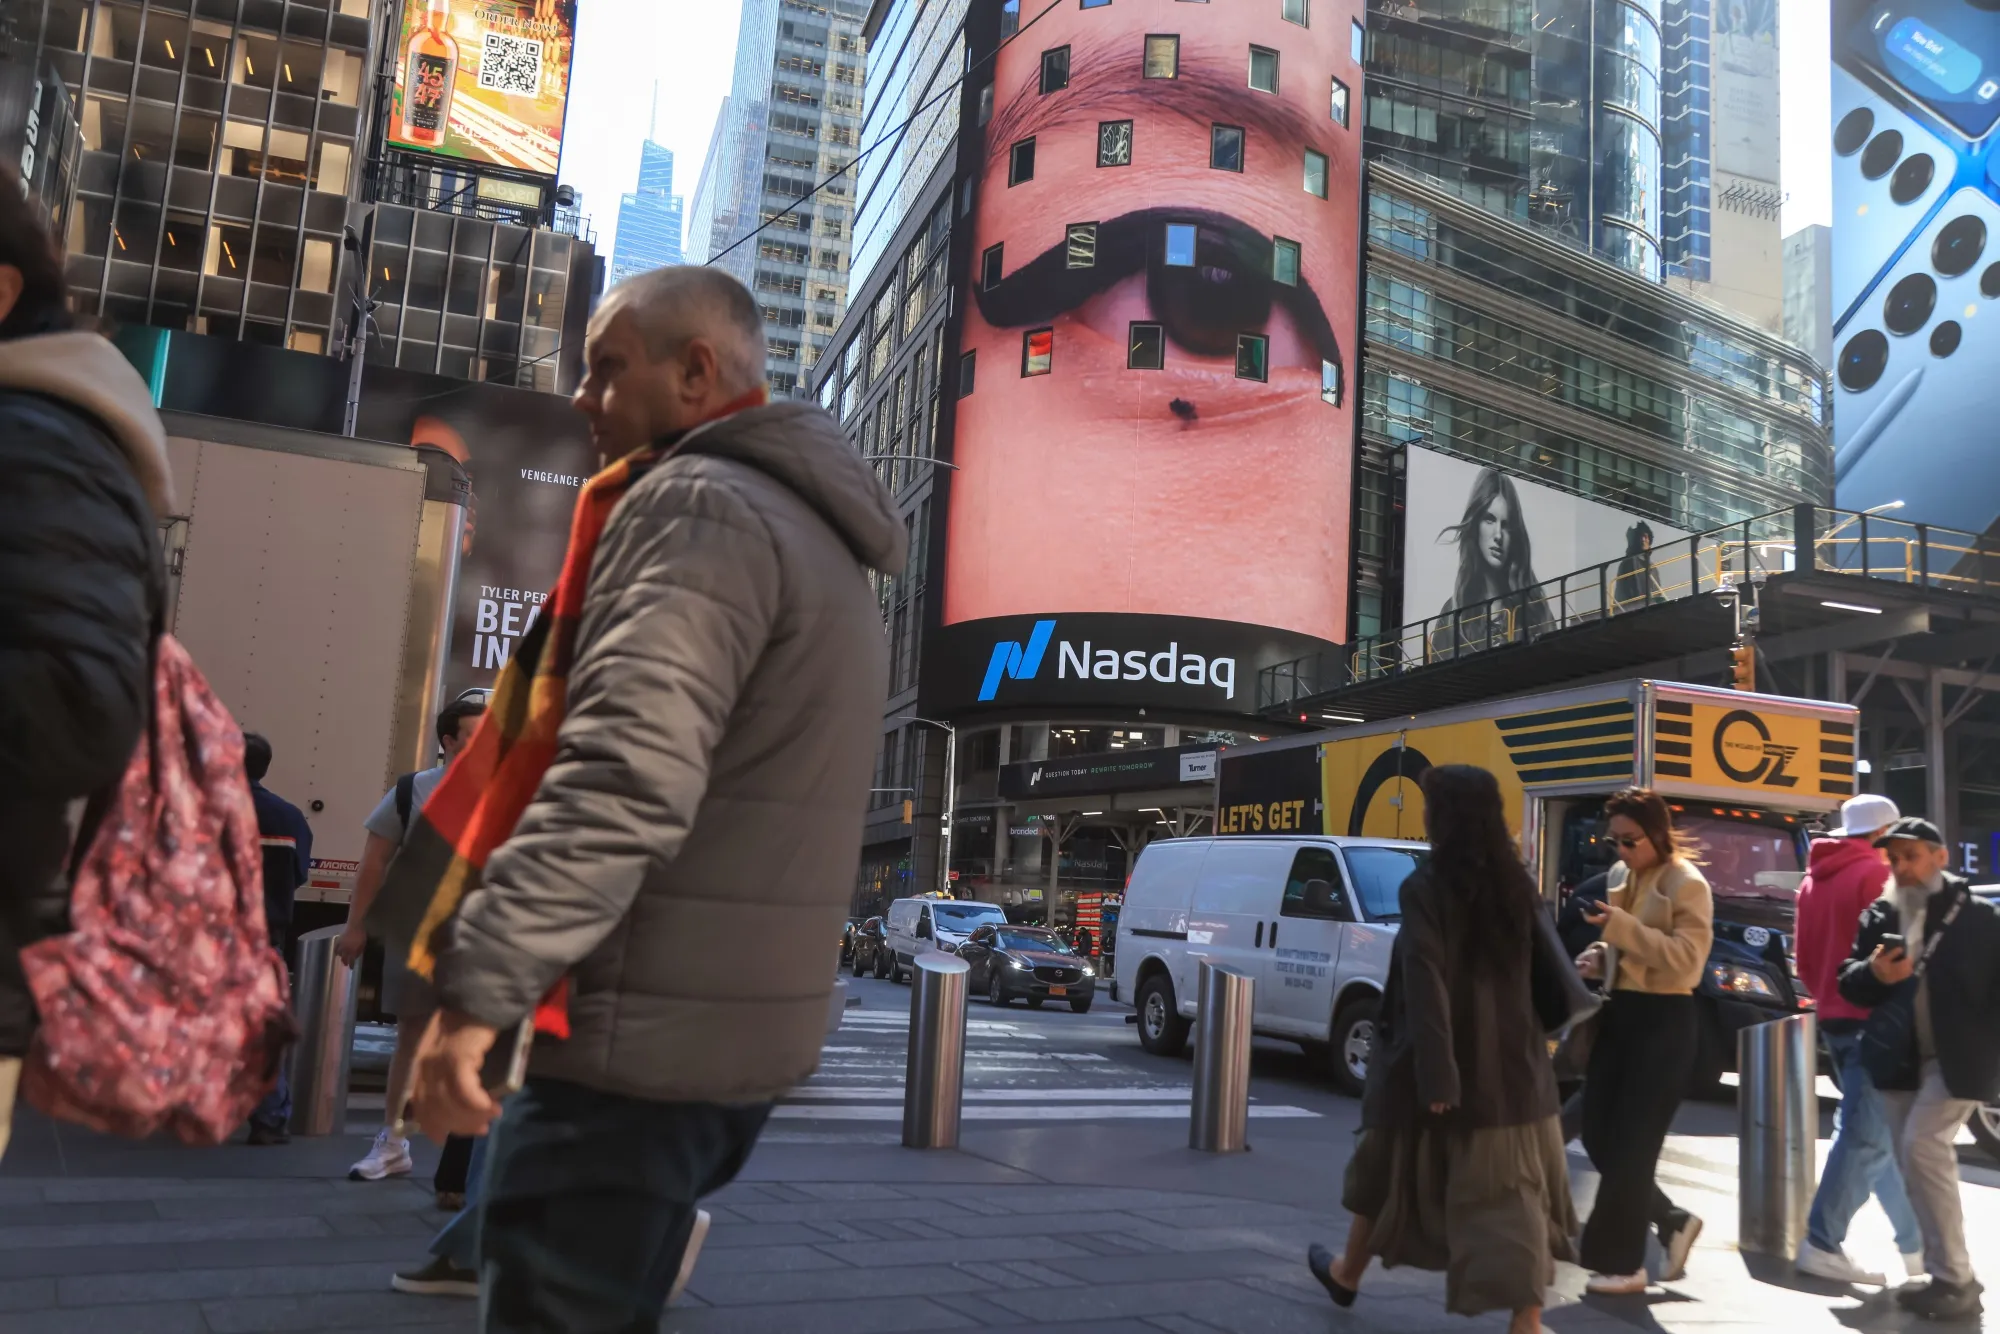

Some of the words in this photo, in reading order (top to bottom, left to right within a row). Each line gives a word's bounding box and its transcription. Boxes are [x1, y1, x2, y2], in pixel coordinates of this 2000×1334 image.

[475, 9, 520, 27] ORDER
[522, 16, 559, 34] NOW!
[418, 61, 444, 87] 45
[415, 83, 442, 108] 47
[521, 468, 579, 487] VENGEANCE
[481, 585, 519, 601] TYLER
[471, 633, 511, 669] IN
[1058, 640, 1235, 700] Nasdaq
[1045, 769, 1070, 778] QUESTION
[1071, 768, 1087, 776] TODAY
[1090, 765, 1117, 774] REWRITE
[1188, 764, 1207, 772] Turner
[1220, 803, 1263, 833] LET'S
[1268, 800, 1304, 830] GET
